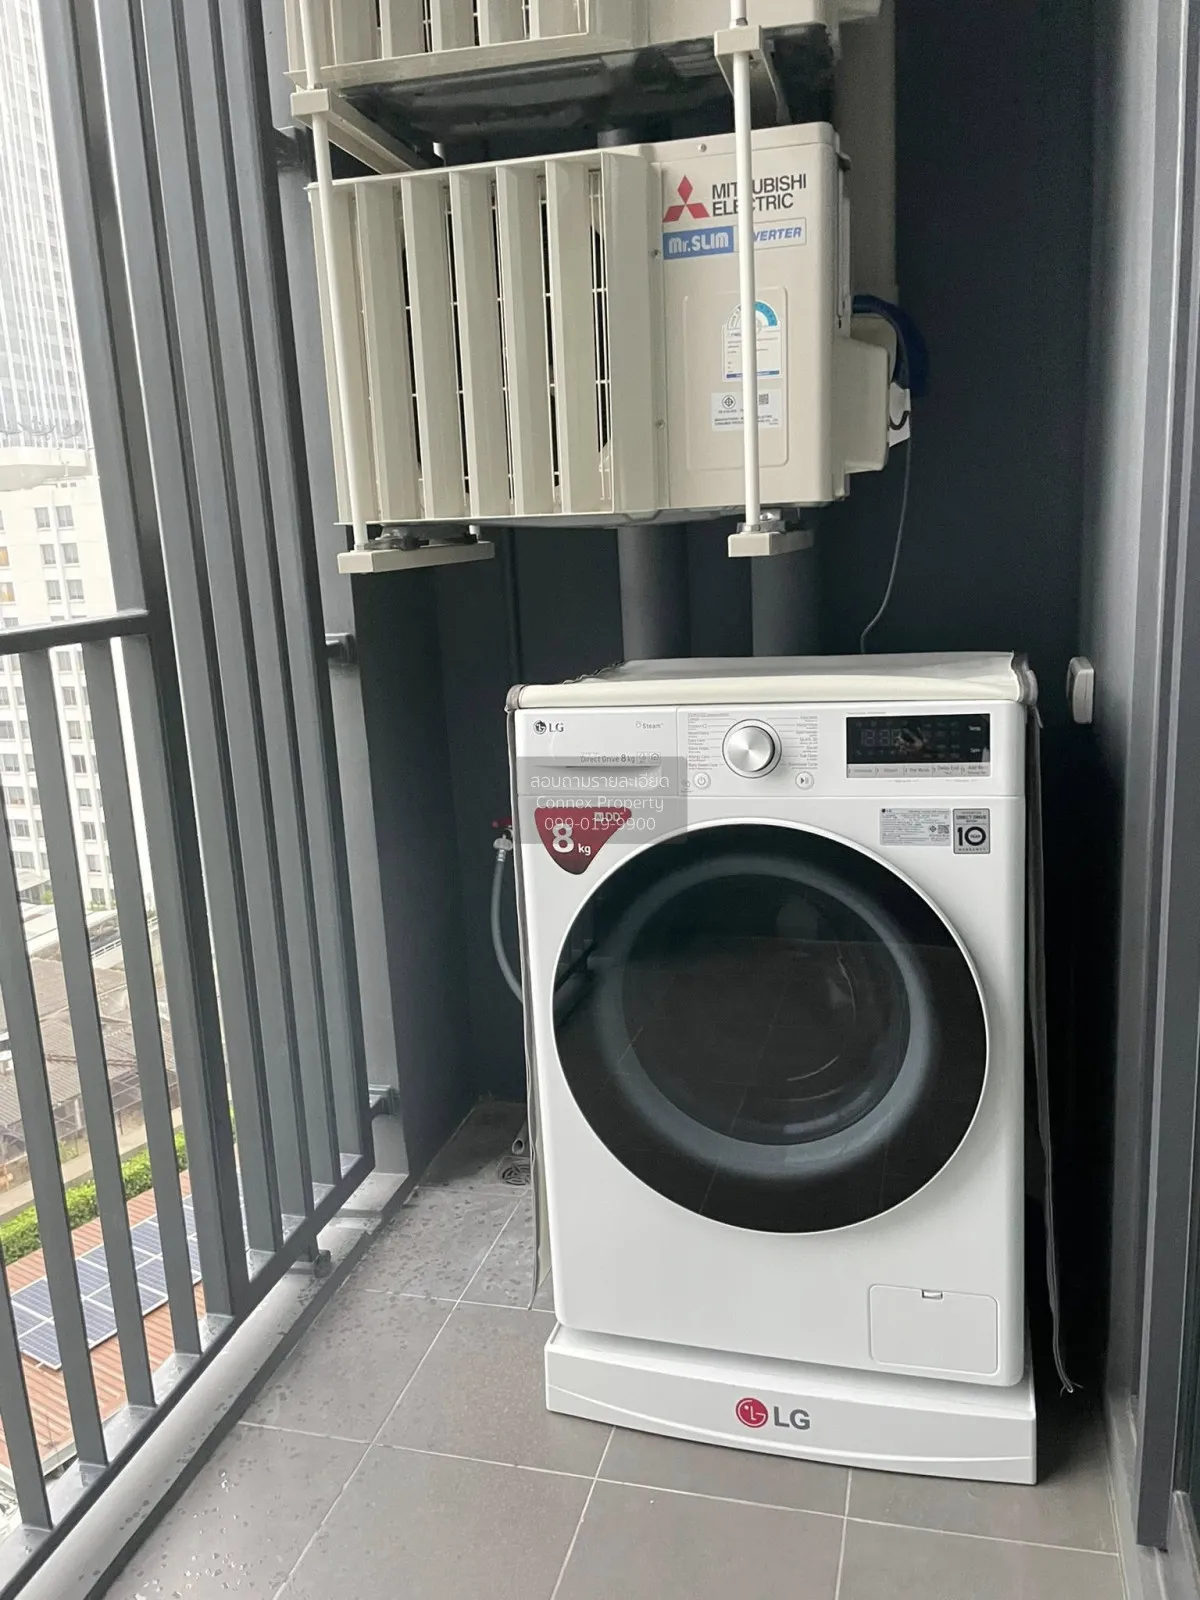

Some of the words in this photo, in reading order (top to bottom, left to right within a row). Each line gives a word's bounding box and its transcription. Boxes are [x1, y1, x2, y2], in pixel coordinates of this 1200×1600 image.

[712, 173, 807, 200] MITUBISHI
[712, 192, 794, 217] ELETRIC
[755, 226, 802, 242] VERTER
[548, 722, 564, 733] LG
[580, 755, 601, 763] Direct
[602, 755, 620, 763] Drive
[620, 753, 627, 763] 8
[552, 823, 575, 853] 8
[578, 843, 591, 856] kg
[957, 826, 987, 847] 10
[773, 1405, 811, 1431] LG
